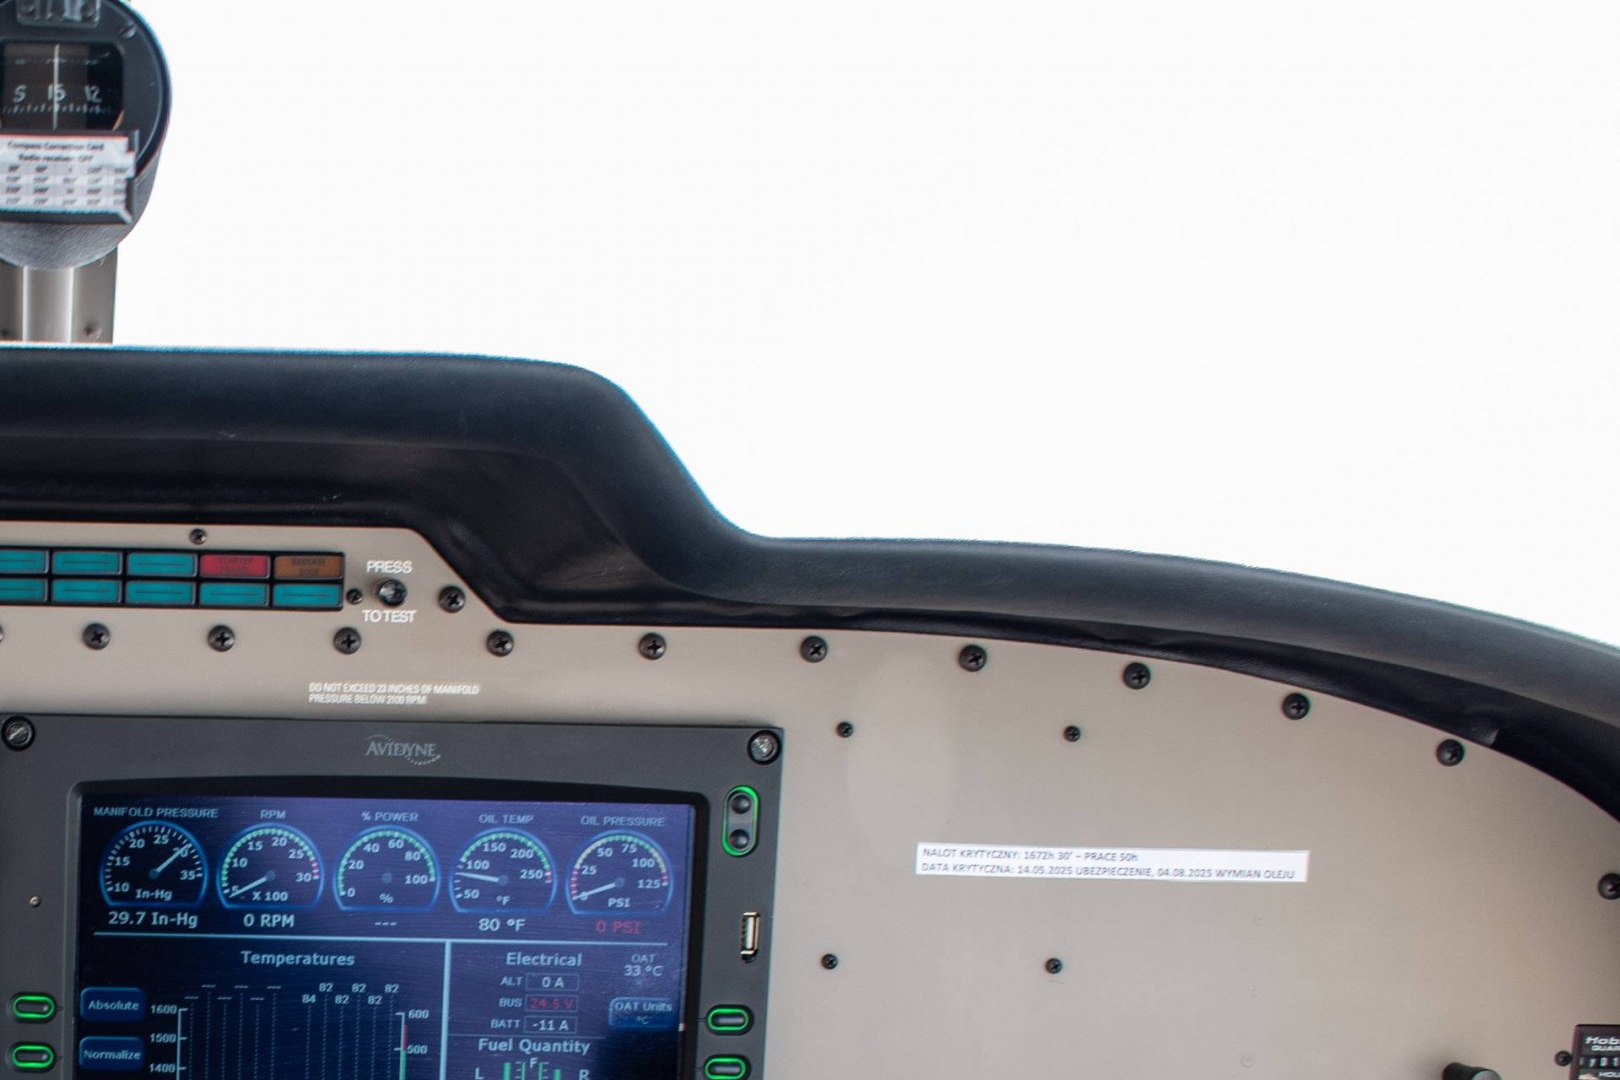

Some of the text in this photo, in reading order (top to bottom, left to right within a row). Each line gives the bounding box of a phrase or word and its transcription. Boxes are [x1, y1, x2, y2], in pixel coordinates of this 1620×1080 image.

[13, 83, 28, 102] S
[366, 561, 413, 574] PRESS
[362, 610, 415, 623] TO TEST
[309, 683, 322, 692] DO
[323, 683, 341, 692] NOT
[433, 685, 480, 695] MANIFOLD
[309, 694, 353, 703] PRESSURE
[354, 694, 386, 704] BELOW
[365, 741, 436, 758] AVIDYNE
[94, 807, 219, 818] MANIFOLD PRESSURE
[260, 810, 286, 819] RPM
[478, 814, 534, 824] OIL TEMP
[581, 816, 666, 826] OIL PRESSURE
[922, 848, 956, 857] NALOT
[1085, 852, 1116, 861] PRACE
[921, 863, 949, 872] DATA
[1265, 870, 1295, 879] OLEJU
[108, 912, 198, 928] 29.7 In-Hg
[244, 914, 294, 927] 0 RPM
[478, 918, 526, 932] 80 °F
[240, 950, 356, 967] Temperatures
[506, 952, 582, 966] Electrical
[623, 965, 643, 976] 33
[87, 1000, 140, 1012] Absolute
[478, 1038, 591, 1054] Fuel Quantity
[84, 1049, 141, 1060] Normalize
